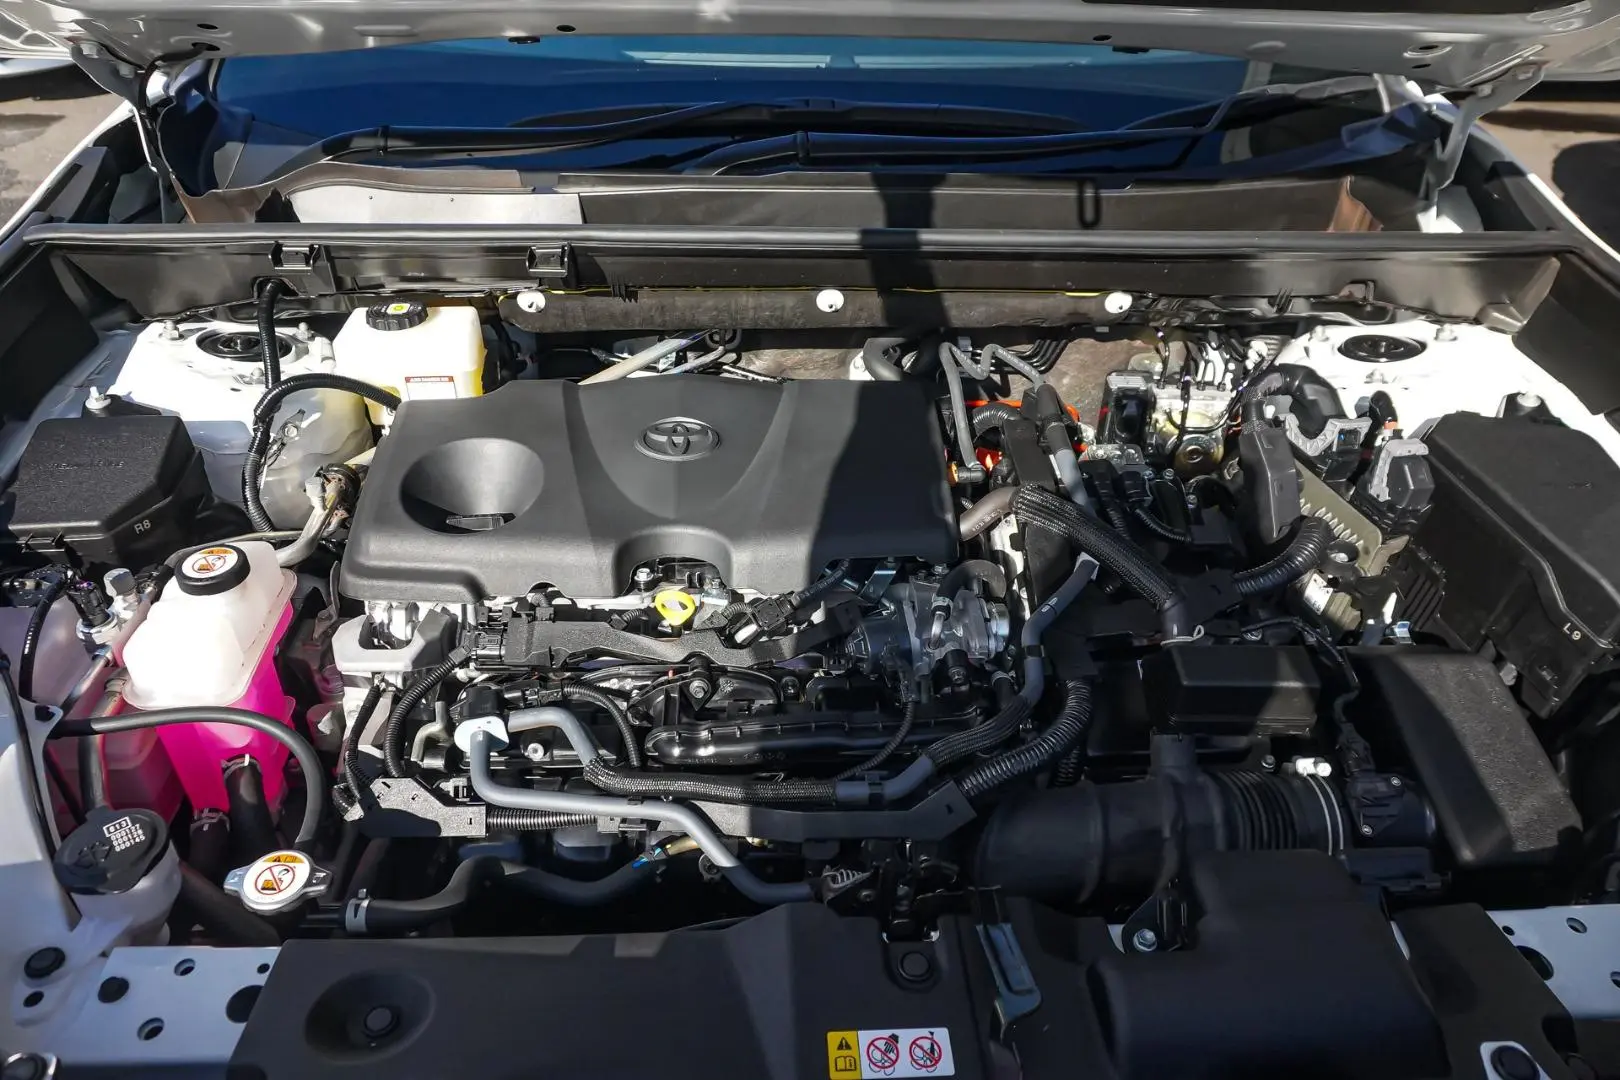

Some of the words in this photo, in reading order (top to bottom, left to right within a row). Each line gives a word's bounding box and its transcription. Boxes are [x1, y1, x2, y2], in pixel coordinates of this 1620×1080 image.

[134, 519, 151, 535] R8
[1563, 622, 1581, 640] L9
[110, 823, 140, 841] 000127
[115, 834, 145, 852] 000145
